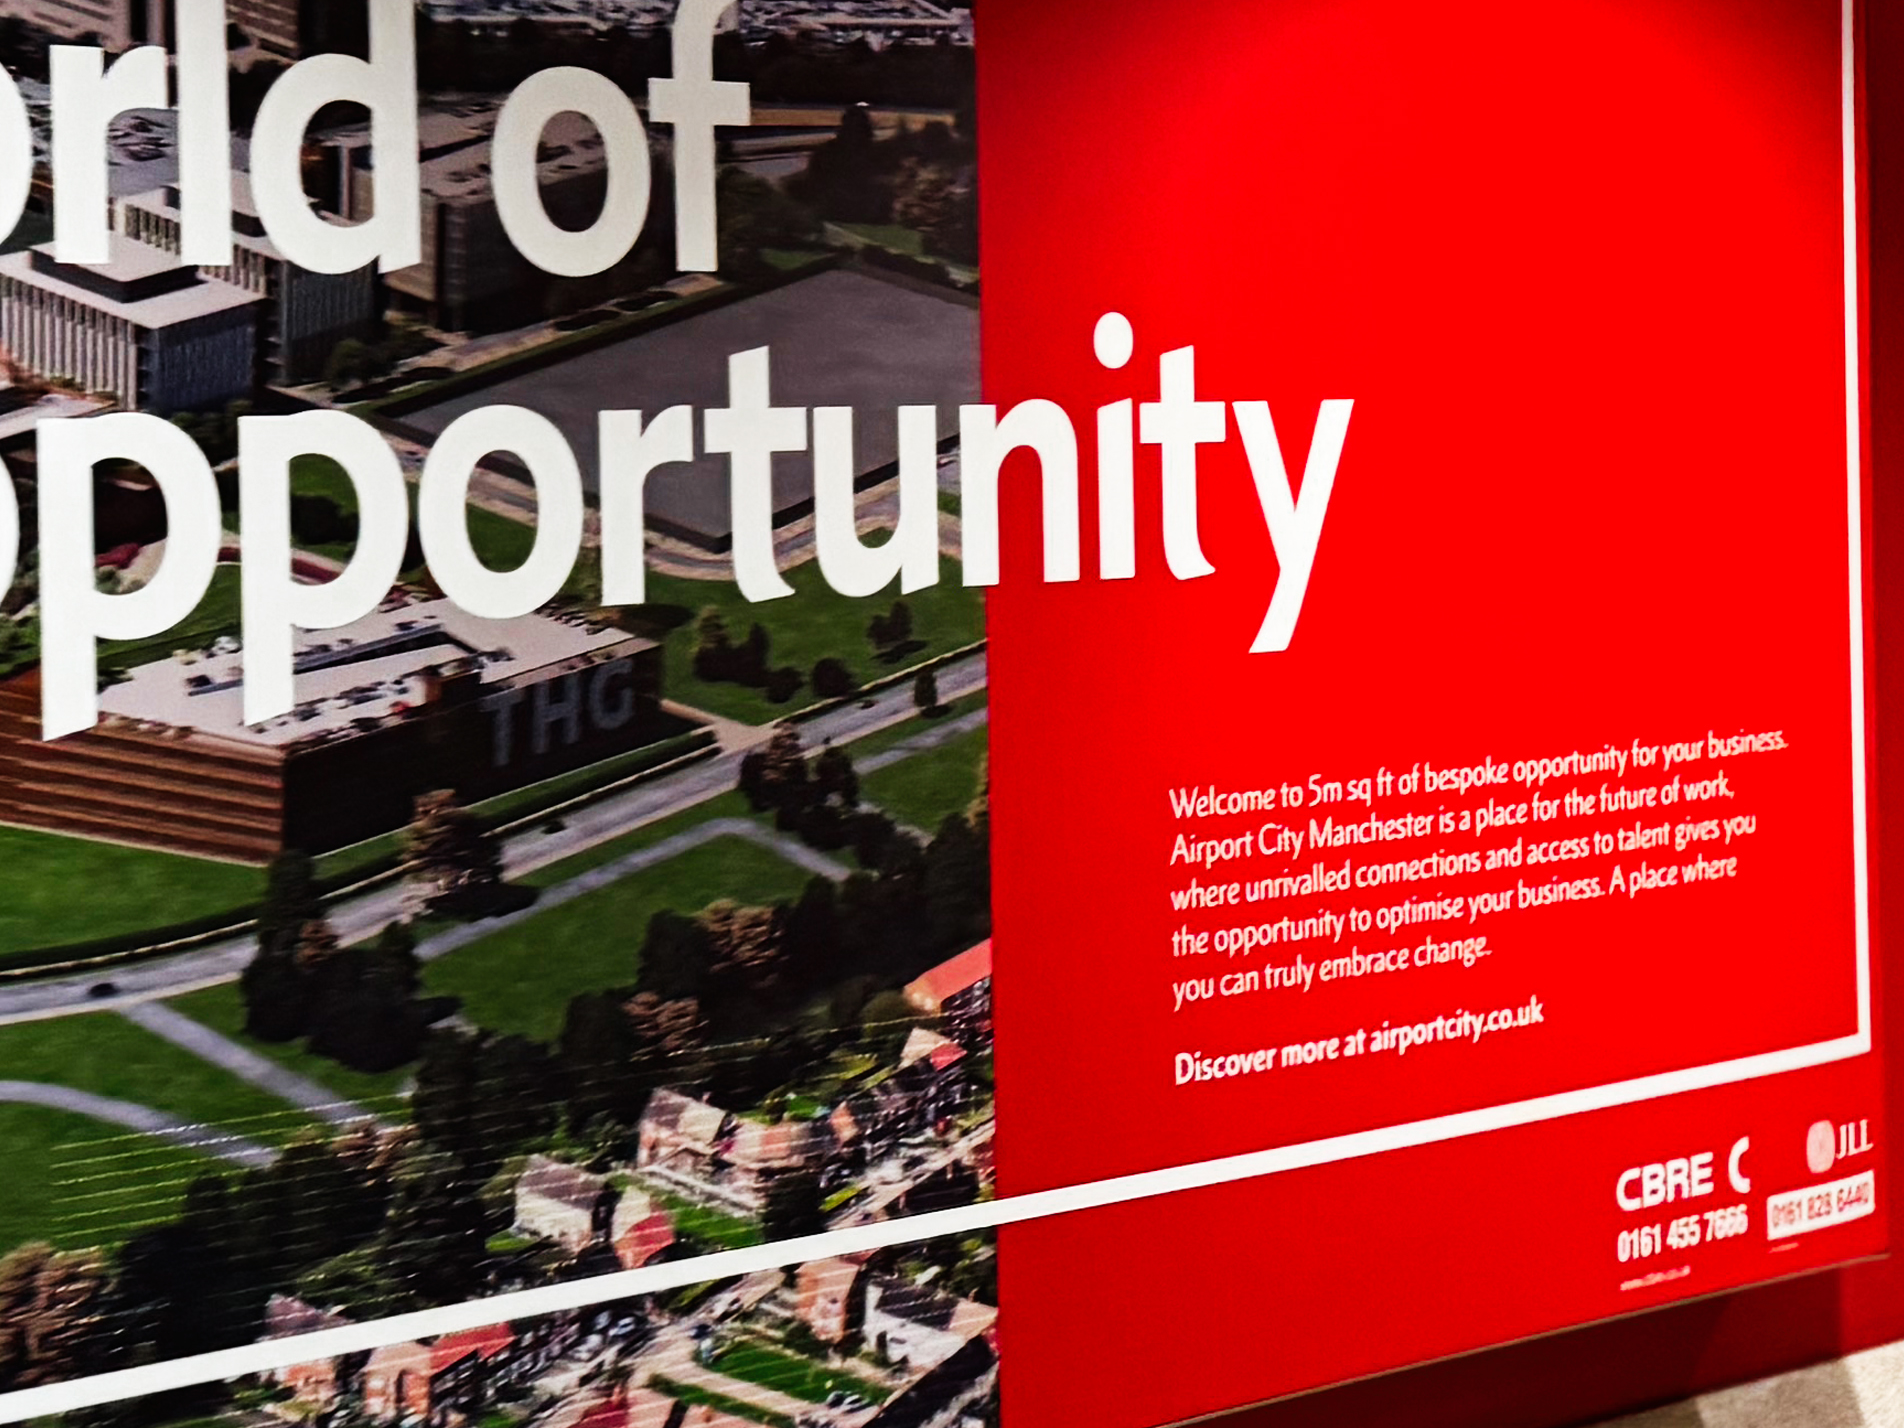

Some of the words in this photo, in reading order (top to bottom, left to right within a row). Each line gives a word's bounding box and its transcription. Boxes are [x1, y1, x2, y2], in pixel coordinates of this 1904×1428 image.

[479, 658, 635, 767] THG
[1169, 785, 1276, 819] Welcome
[1280, 782, 1303, 807] to
[1308, 774, 1342, 807] 5m
[1347, 778, 1371, 807] sq
[1376, 767, 1395, 796] ft
[1398, 763, 1420, 795] of
[1424, 755, 1509, 795] bespoke
[1513, 744, 1628, 788] opportunity
[1631, 738, 1660, 767] for
[1662, 740, 1705, 771] your
[1708, 729, 1788, 759] business.
[1170, 831, 1254, 869] Airport
[1258, 823, 1305, 860] City
[1309, 812, 1434, 849] Manchester
[1439, 805, 1455, 833] is
[1459, 810, 1471, 831] a
[1475, 798, 1528, 837] place
[1532, 791, 1561, 821] for
[1564, 787, 1596, 818] the
[1599, 783, 1657, 813] future
[1660, 775, 1680, 805] of
[1683, 770, 1734, 801] work,
[1170, 878, 1240, 911] where
[1245, 859, 1351, 902] unrivalled
[1355, 849, 1482, 888] connections
[1485, 837, 1522, 871] and
[1526, 837, 1590, 865] access
[1593, 831, 1614, 855] to
[1617, 821, 1671, 851] talent
[1675, 816, 1720, 851] gives
[1722, 815, 1756, 845] you
[1171, 924, 1209, 957] the
[1214, 908, 1345, 958] opportunity
[1349, 907, 1372, 932] to
[1376, 892, 1464, 935] optimise
[1468, 890, 1514, 924] your
[1518, 876, 1606, 909] business.
[1609, 865, 1626, 895] A
[1629, 861, 1678, 899] place
[1682, 853, 1737, 883] where
[1172, 978, 1214, 1012] you
[1220, 971, 1259, 996] can
[1264, 954, 1315, 992] truly
[1319, 946, 1409, 981] embrace
[1414, 935, 1492, 968] change.
[1175, 1048, 1277, 1085] Discover
[1281, 1037, 1340, 1067] more
[1343, 1028, 1367, 1056] at
[1370, 995, 1544, 1055] airportcity.co.uk
[1616, 1151, 1714, 1211] CBRE
[1836, 1119, 1874, 1159] JLL
[1617, 1223, 1662, 1263] 0161
[1666, 1214, 1701, 1250] 455
